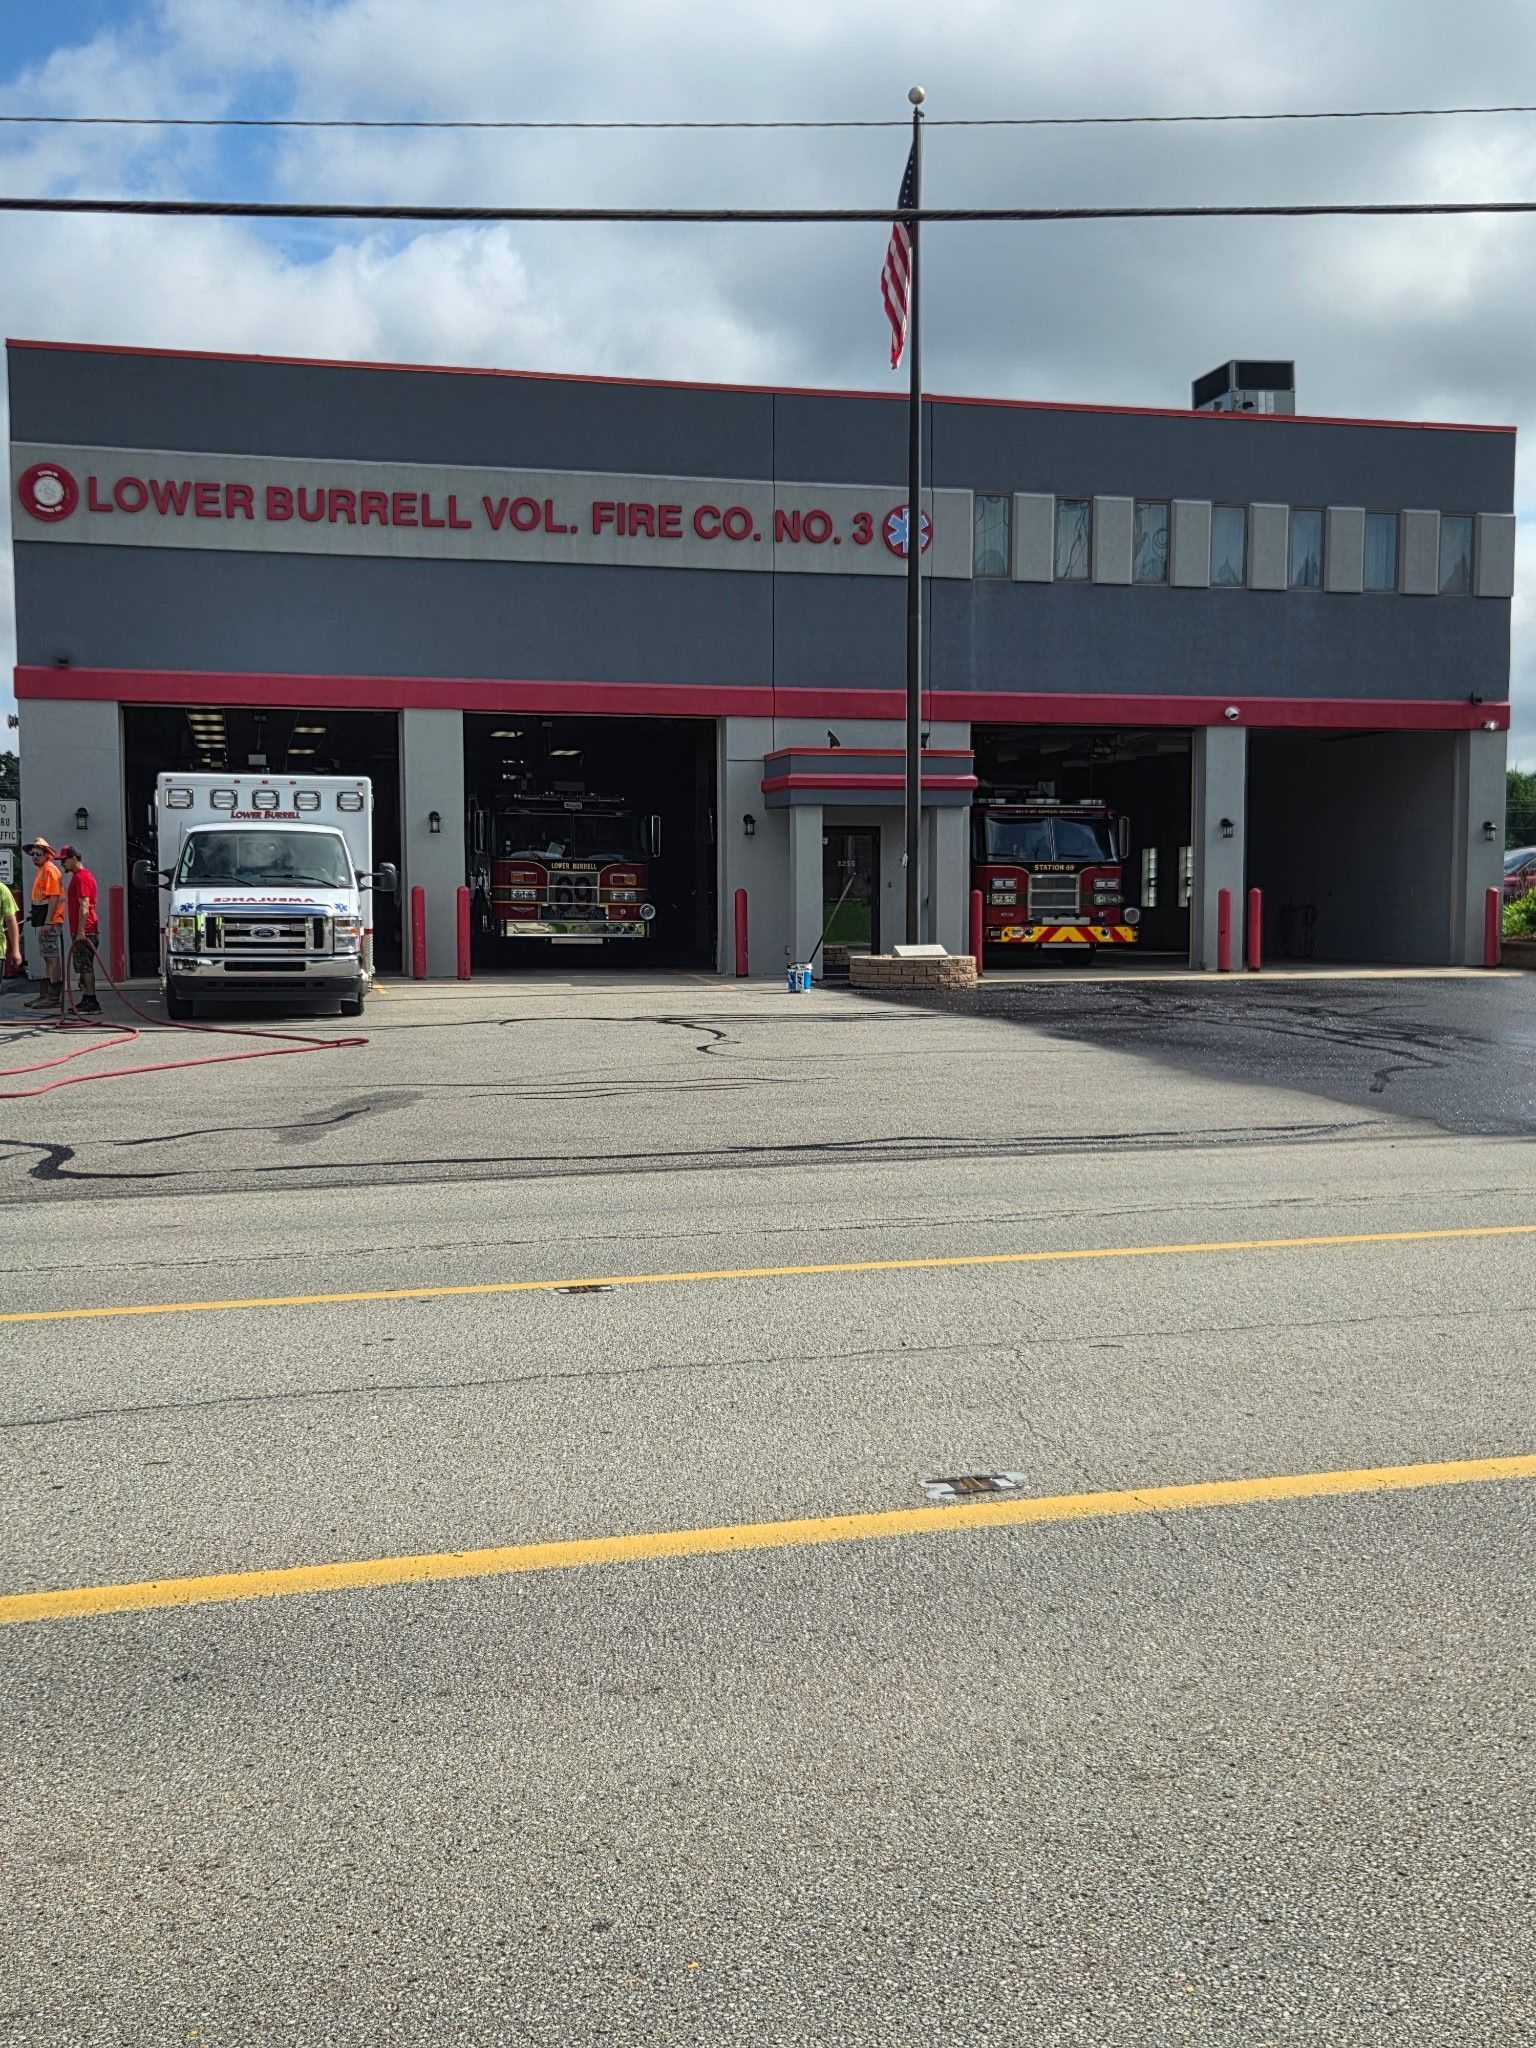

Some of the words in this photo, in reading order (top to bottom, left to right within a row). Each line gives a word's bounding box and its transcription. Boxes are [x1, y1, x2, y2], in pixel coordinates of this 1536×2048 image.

[87, 476, 255, 519] LOWER
[266, 486, 472, 529] BURRELL
[482, 496, 578, 533] VOL.
[592, 502, 682, 538] FIRE
[693, 505, 762, 541] CO.
[774, 509, 841, 544] NO.
[852, 512, 874, 545] 3
[231, 810, 262, 819] LOWER
[264, 810, 301, 819] BURRELL
